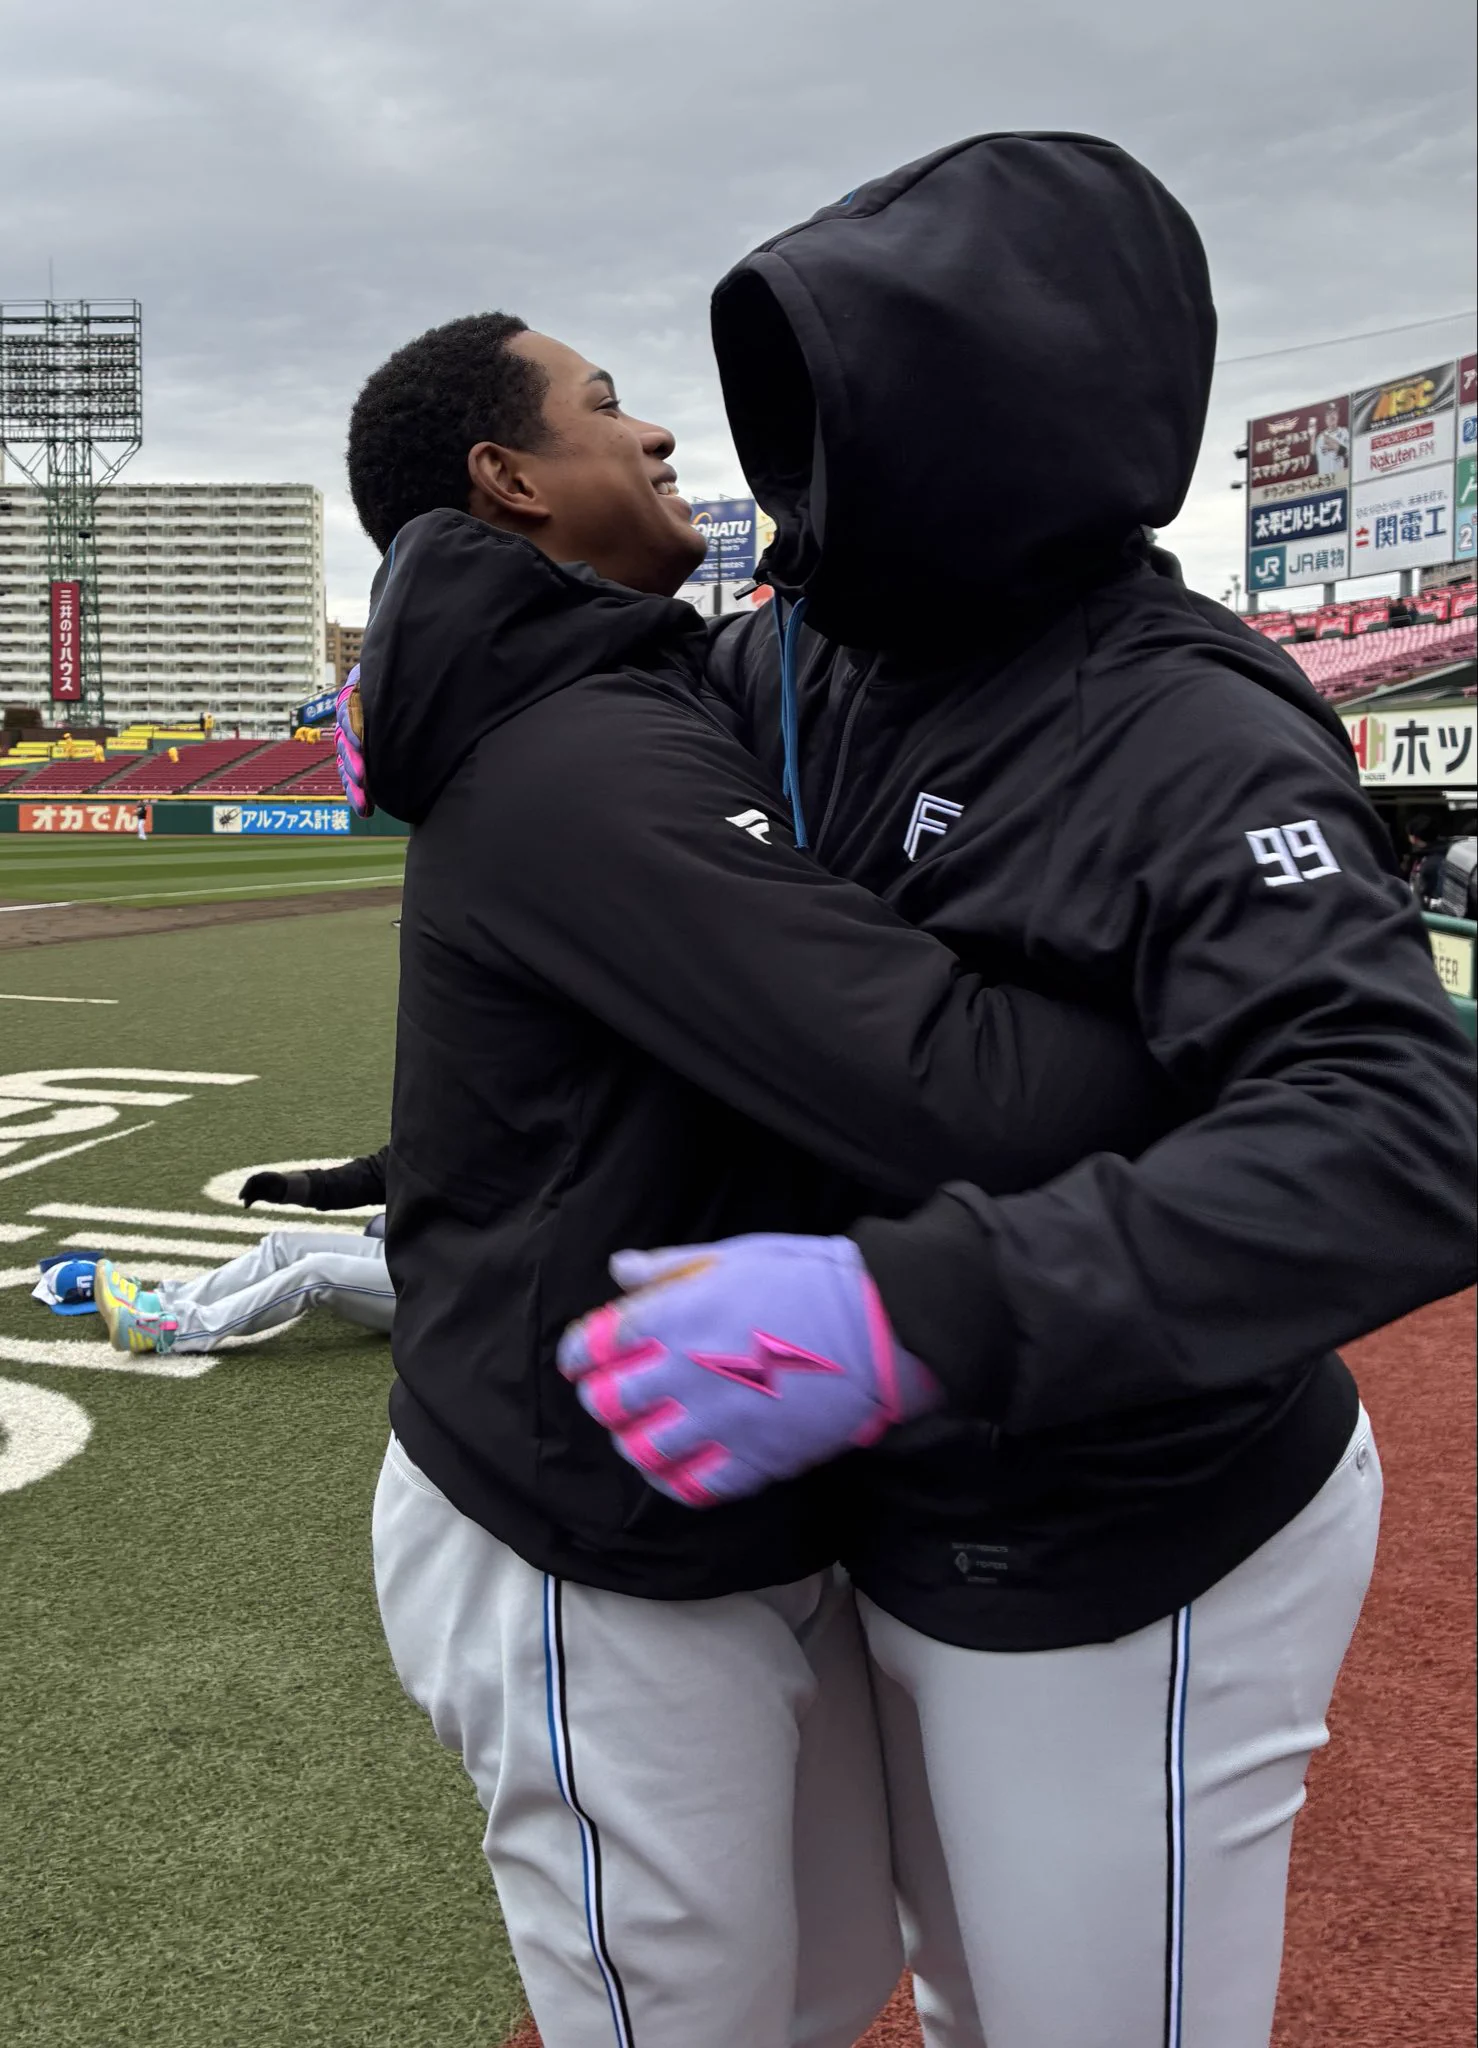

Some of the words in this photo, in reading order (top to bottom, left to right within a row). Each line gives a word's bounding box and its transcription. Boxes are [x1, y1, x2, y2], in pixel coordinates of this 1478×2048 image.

[691, 520, 752, 537] OHATU
[1255, 498, 1343, 539] 太平ビルサービス
[1375, 505, 1447, 550] 関電工
[1255, 556, 1280, 578] JR
[1288, 548, 1345, 575] JR貨物
[59, 589, 73, 692] 三井のリハウス
[32, 805, 139, 831] オカでん
[242, 809, 349, 830] アルファス計装
[1245, 819, 1342, 887] 99
